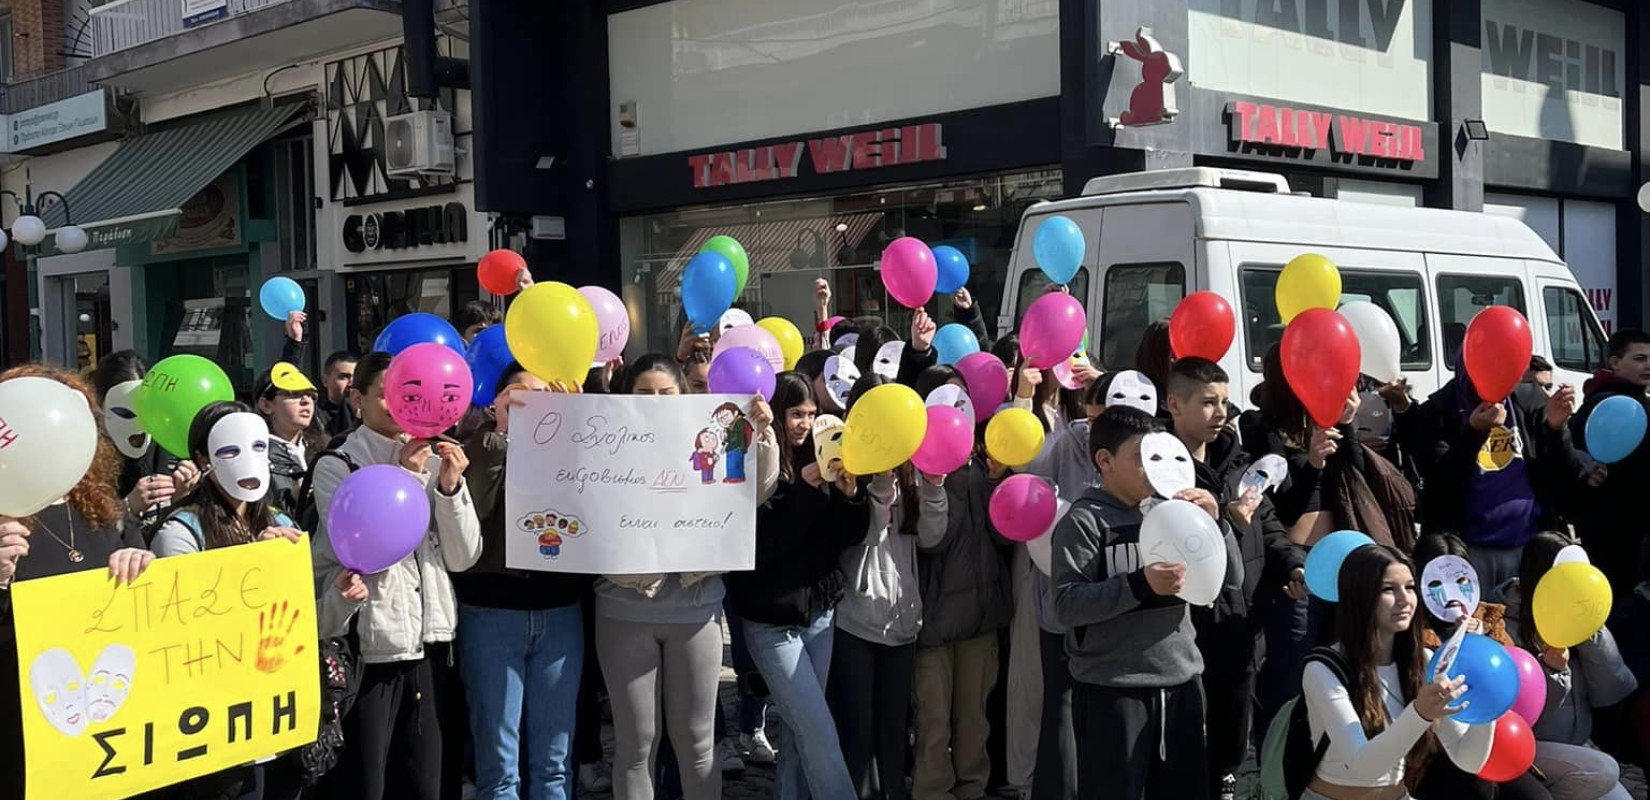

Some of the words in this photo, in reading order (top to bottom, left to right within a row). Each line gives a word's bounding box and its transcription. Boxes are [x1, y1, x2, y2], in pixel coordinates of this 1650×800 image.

[1235, 101, 1332, 149] TALLY
[688, 142, 804, 188] TALLY
[84, 567, 267, 634] ΣΠΑΣΕ
[148, 632, 244, 685] ΤΗΝ
[91, 690, 296, 779] ΣΙΩΠΗ
